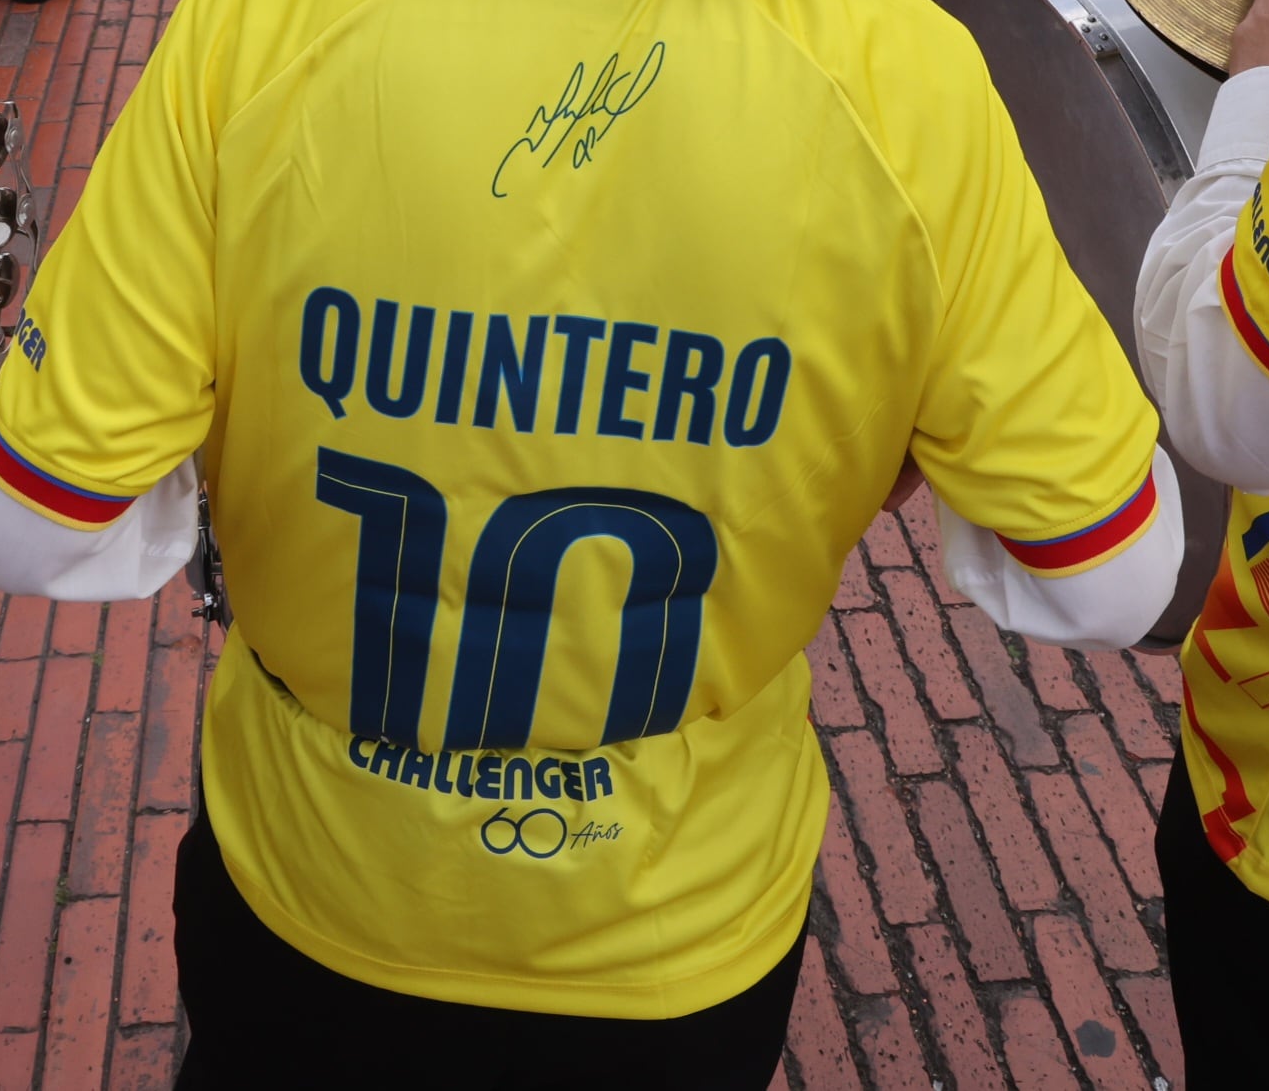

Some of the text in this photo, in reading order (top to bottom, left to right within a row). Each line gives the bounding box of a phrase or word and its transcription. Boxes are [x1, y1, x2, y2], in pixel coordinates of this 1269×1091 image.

[299, 286, 792, 448] QUINTERO
[315, 445, 719, 750] 10
[348, 735, 614, 802] CHALLENGER
[480, 807, 624, 859] 60 Años
